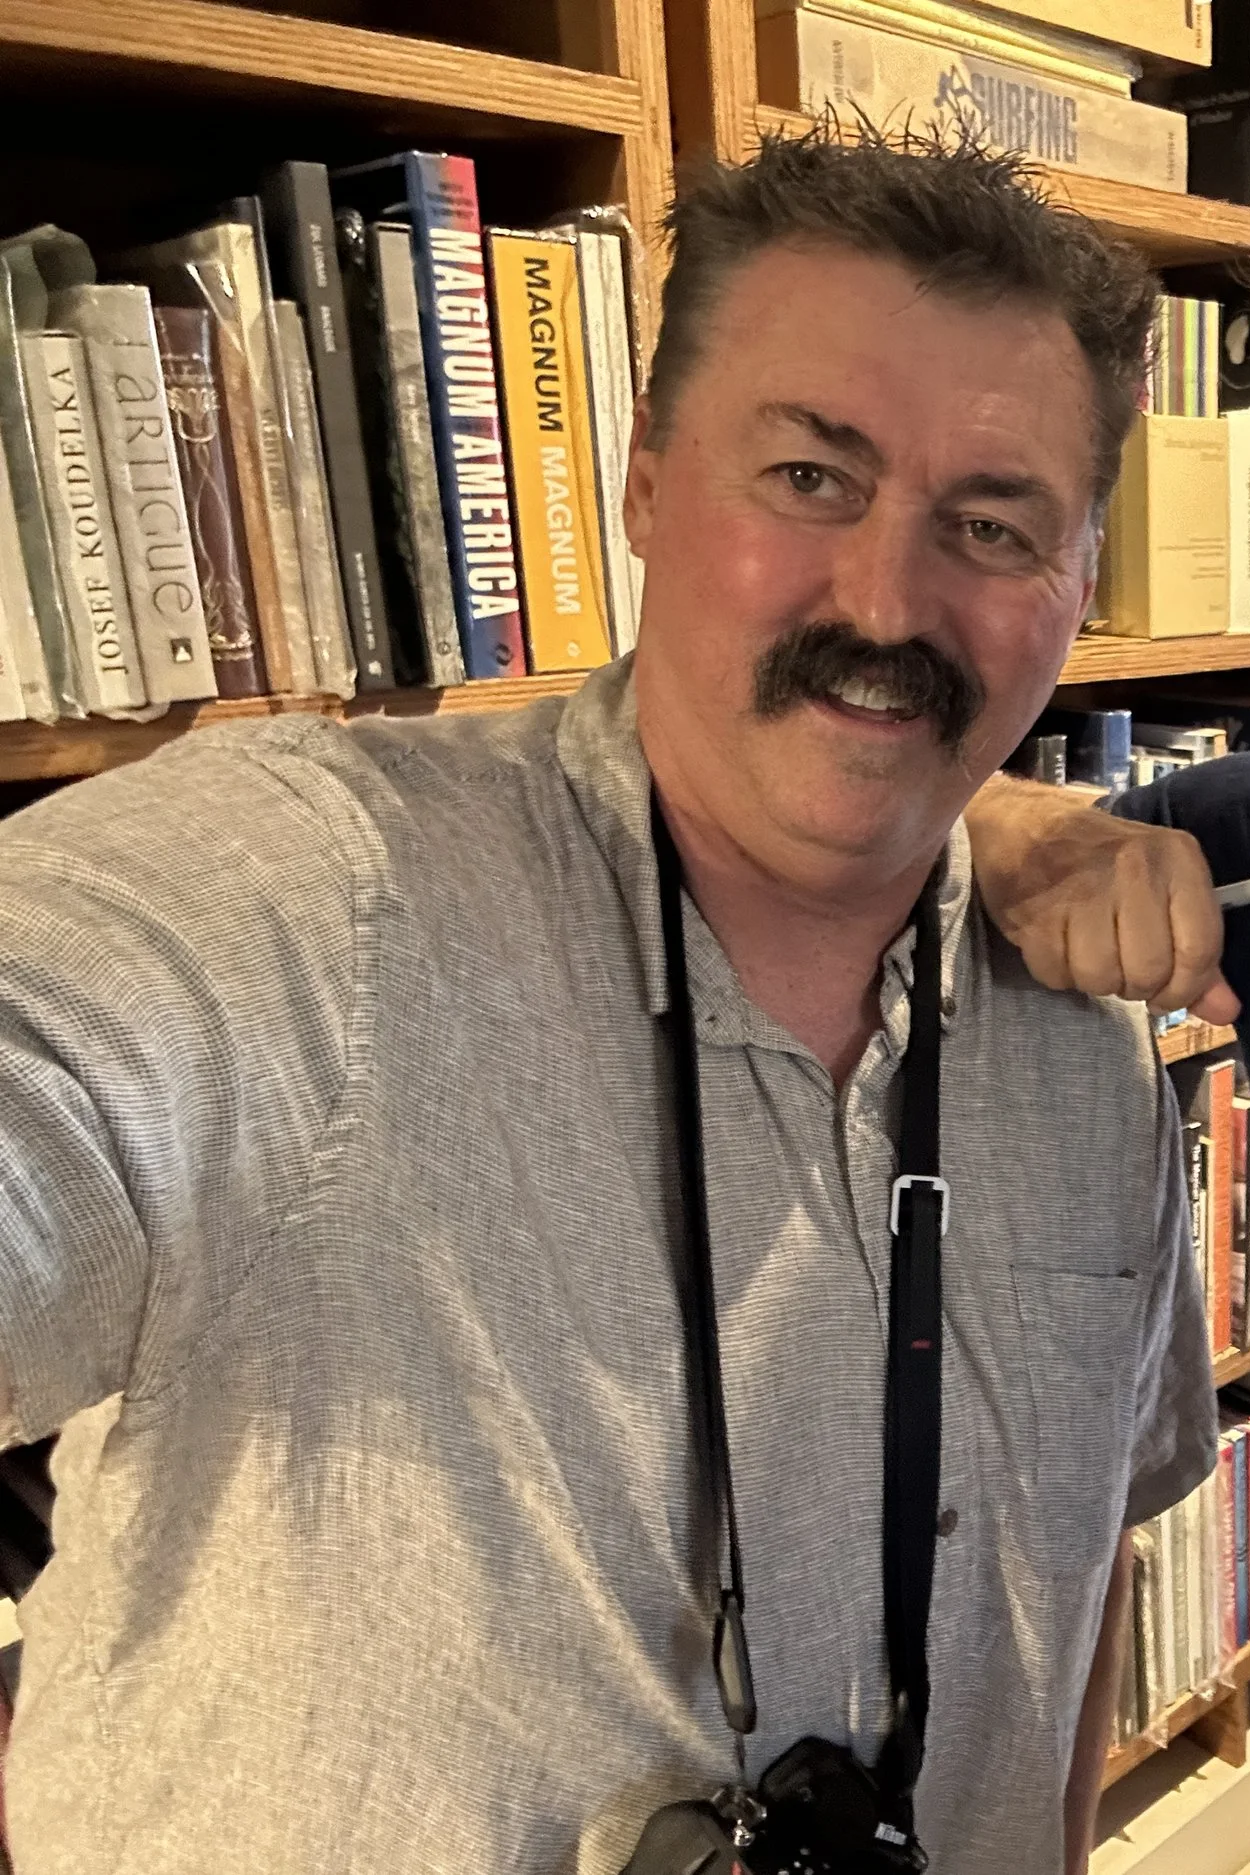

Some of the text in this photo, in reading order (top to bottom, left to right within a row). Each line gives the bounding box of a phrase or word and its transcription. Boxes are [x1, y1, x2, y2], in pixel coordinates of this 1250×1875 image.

[429, 228, 498, 419] MAGNUM
[523, 256, 582, 616] MAGNUM MAGNUM
[49, 367, 129, 675] JOSEF KOUDELKA
[452, 432, 520, 621] AMERICA
